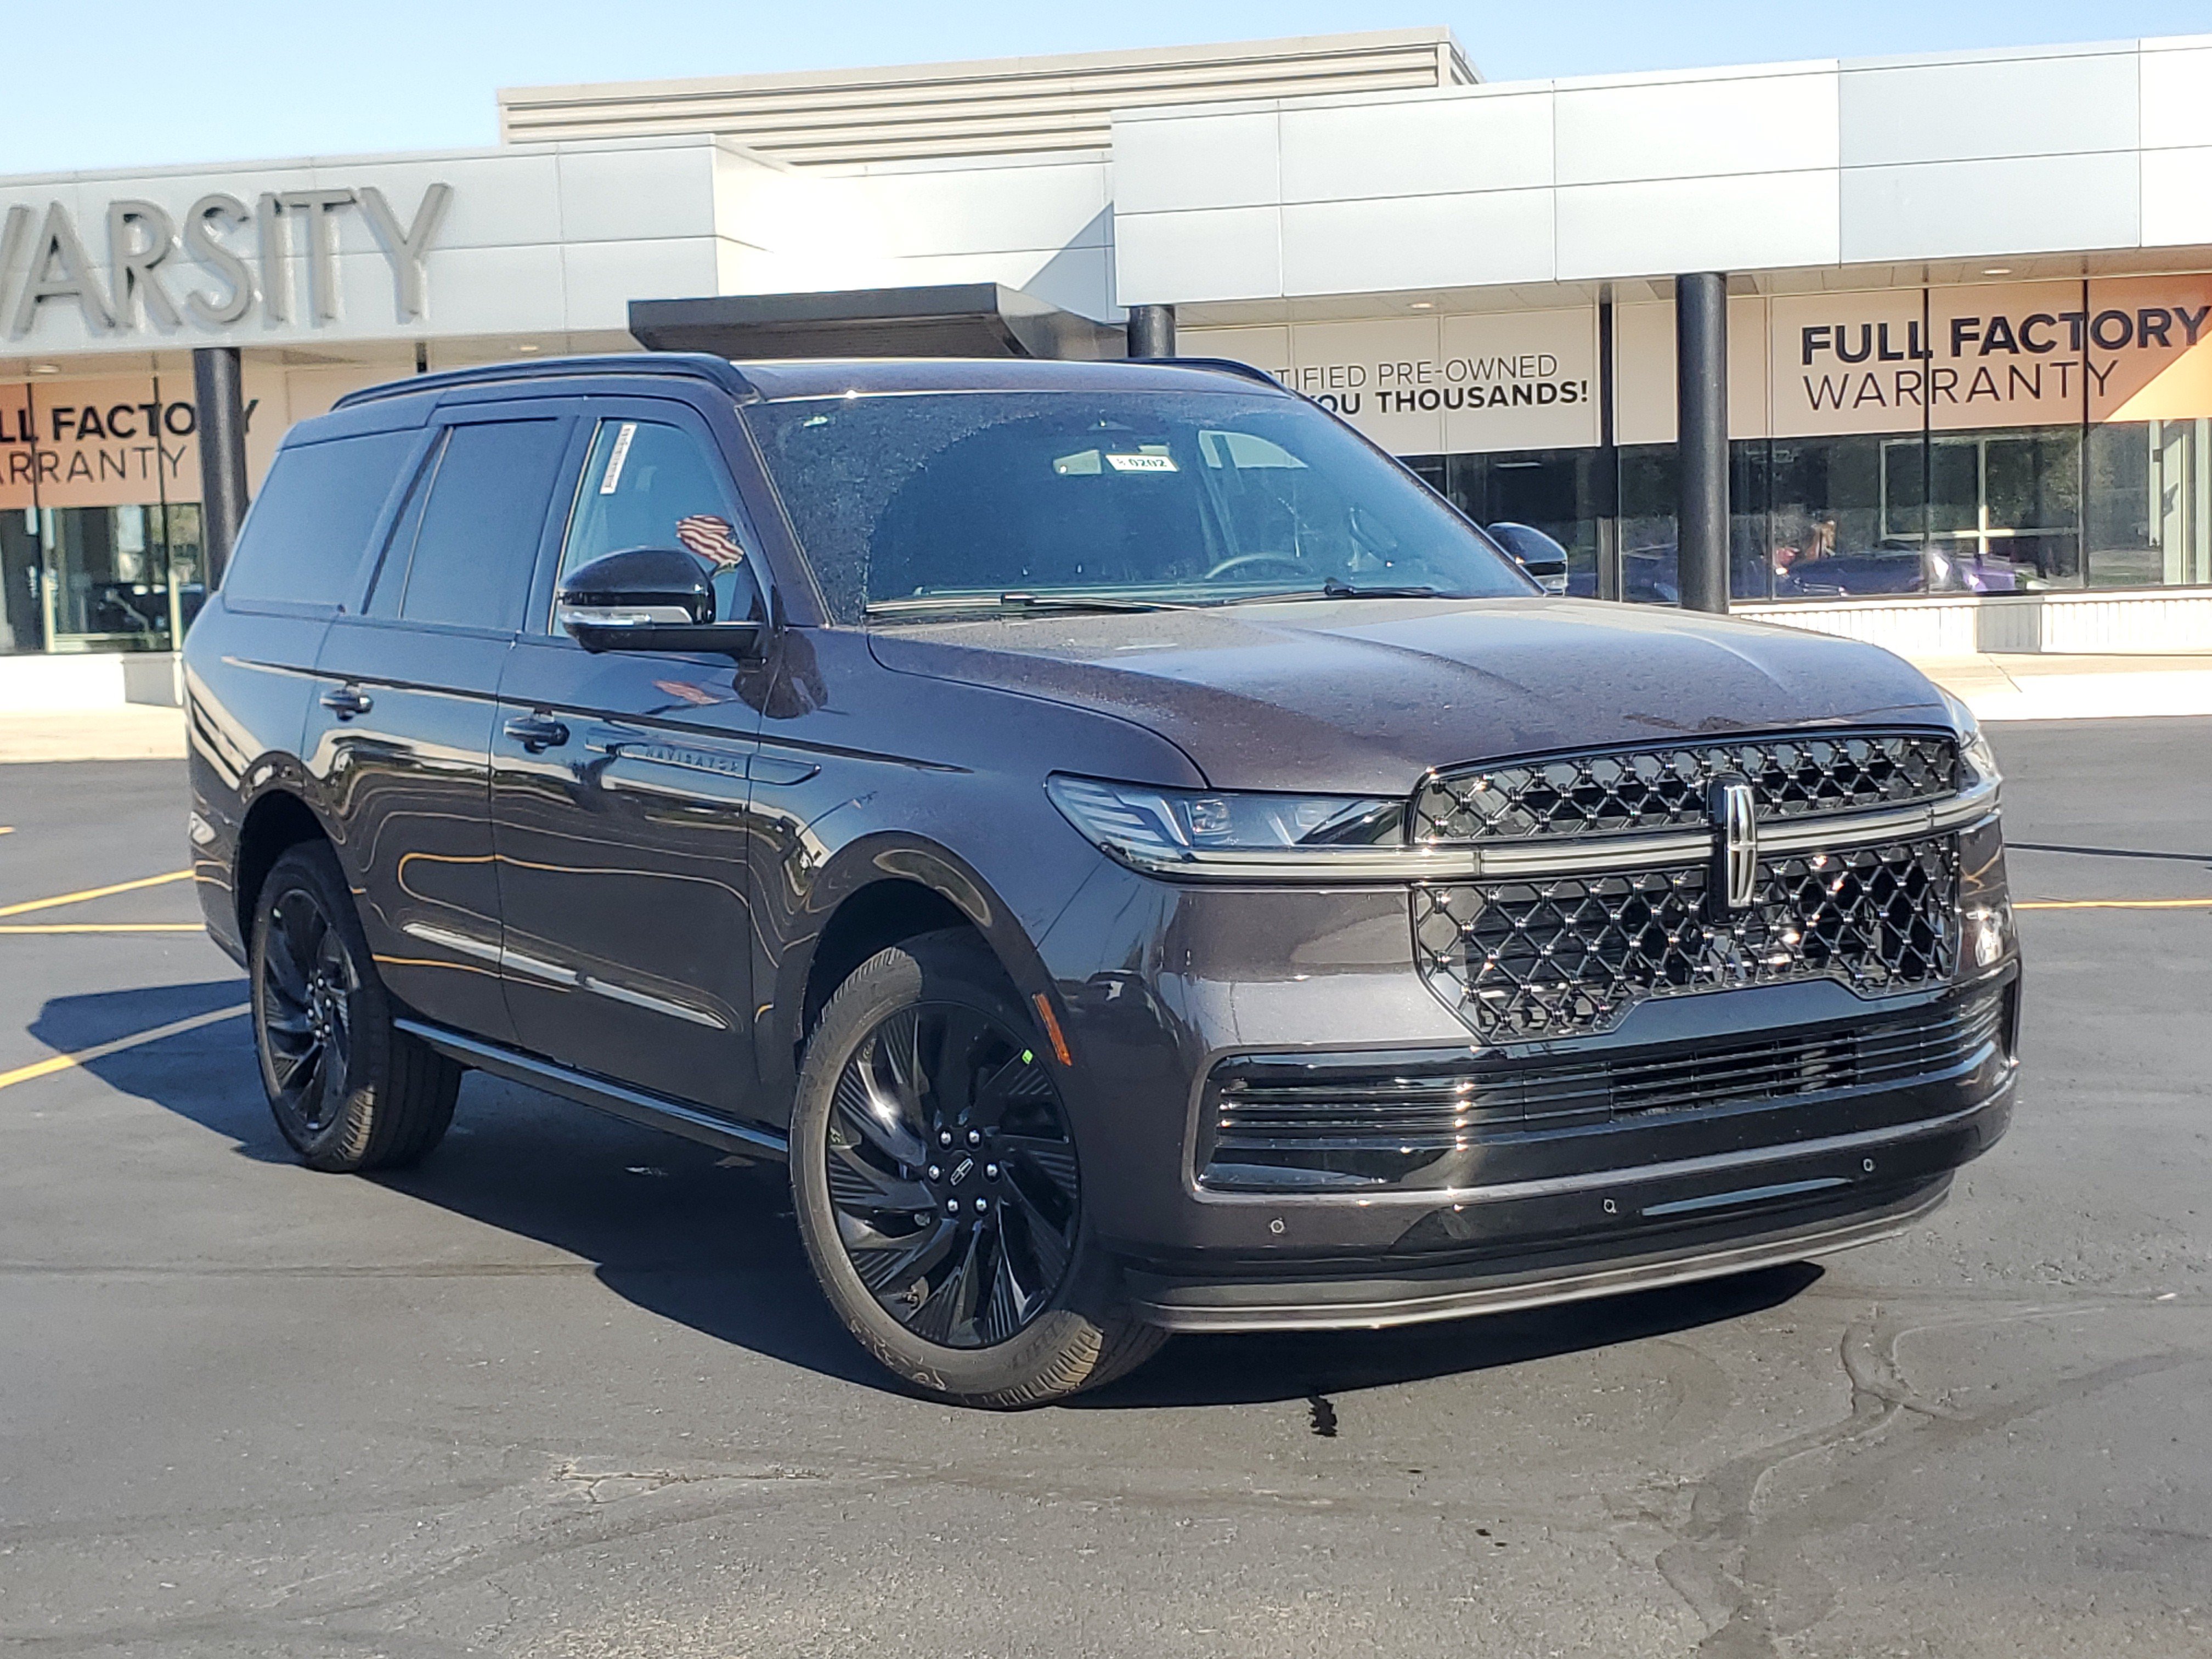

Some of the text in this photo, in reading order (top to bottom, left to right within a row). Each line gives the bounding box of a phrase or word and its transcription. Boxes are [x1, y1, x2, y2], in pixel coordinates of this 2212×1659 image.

[1802, 306, 2212, 365] FULL FACTORY
[1266, 354, 1558, 391] TIFIED PRE-OWNED
[1803, 359, 2118, 411] WARRANTY
[1310, 380, 1588, 415] OU THOUSANDS!
[52, 399, 259, 441] FACTOY
[0, 444, 187, 484] RRANTY
